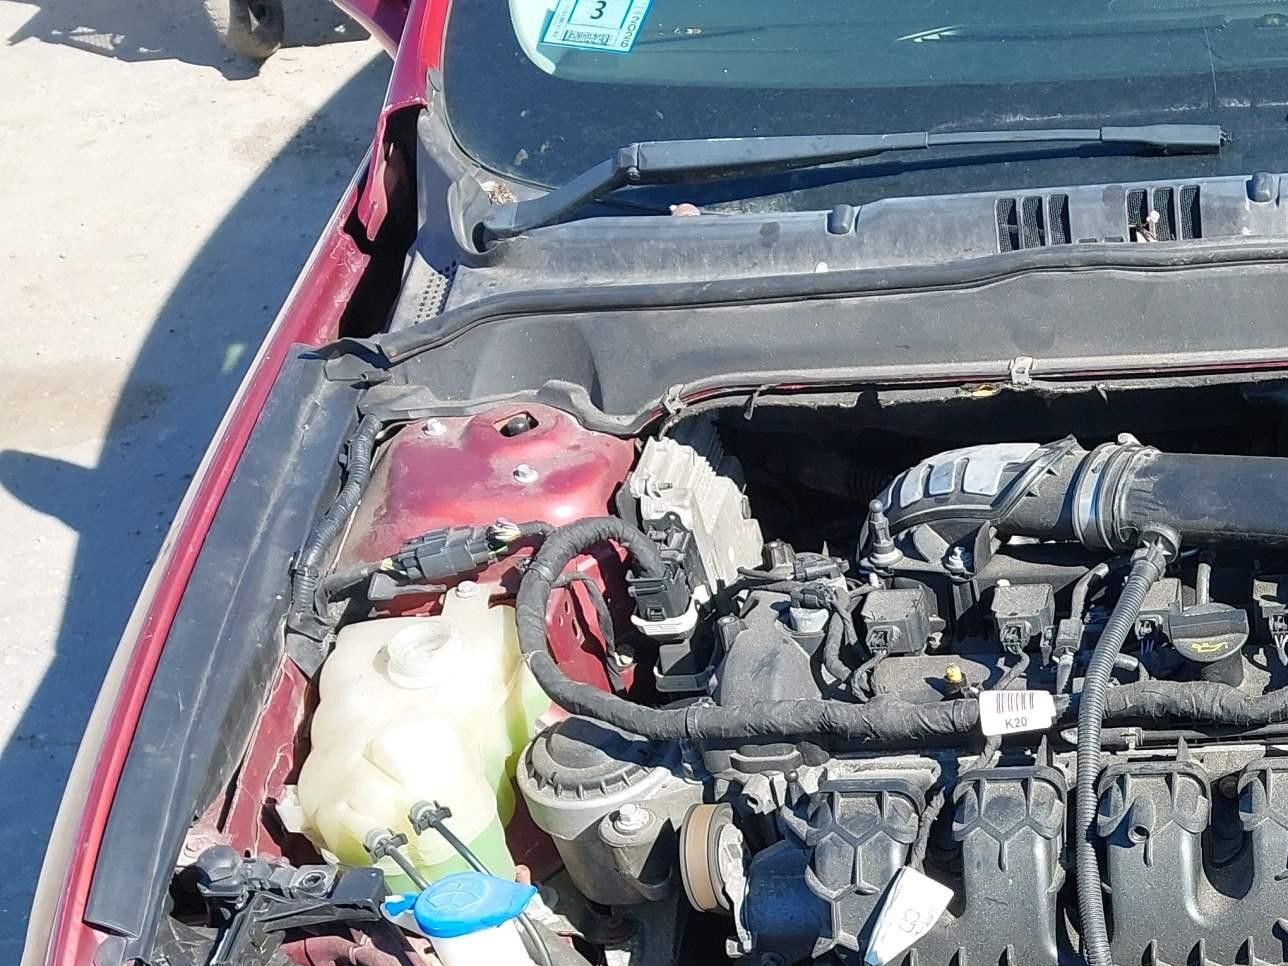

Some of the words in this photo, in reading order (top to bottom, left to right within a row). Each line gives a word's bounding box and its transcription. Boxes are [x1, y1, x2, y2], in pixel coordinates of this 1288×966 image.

[589, 0, 606, 19] 3
[620, 16, 640, 48] 2026
[1005, 717, 1028, 729] K20
